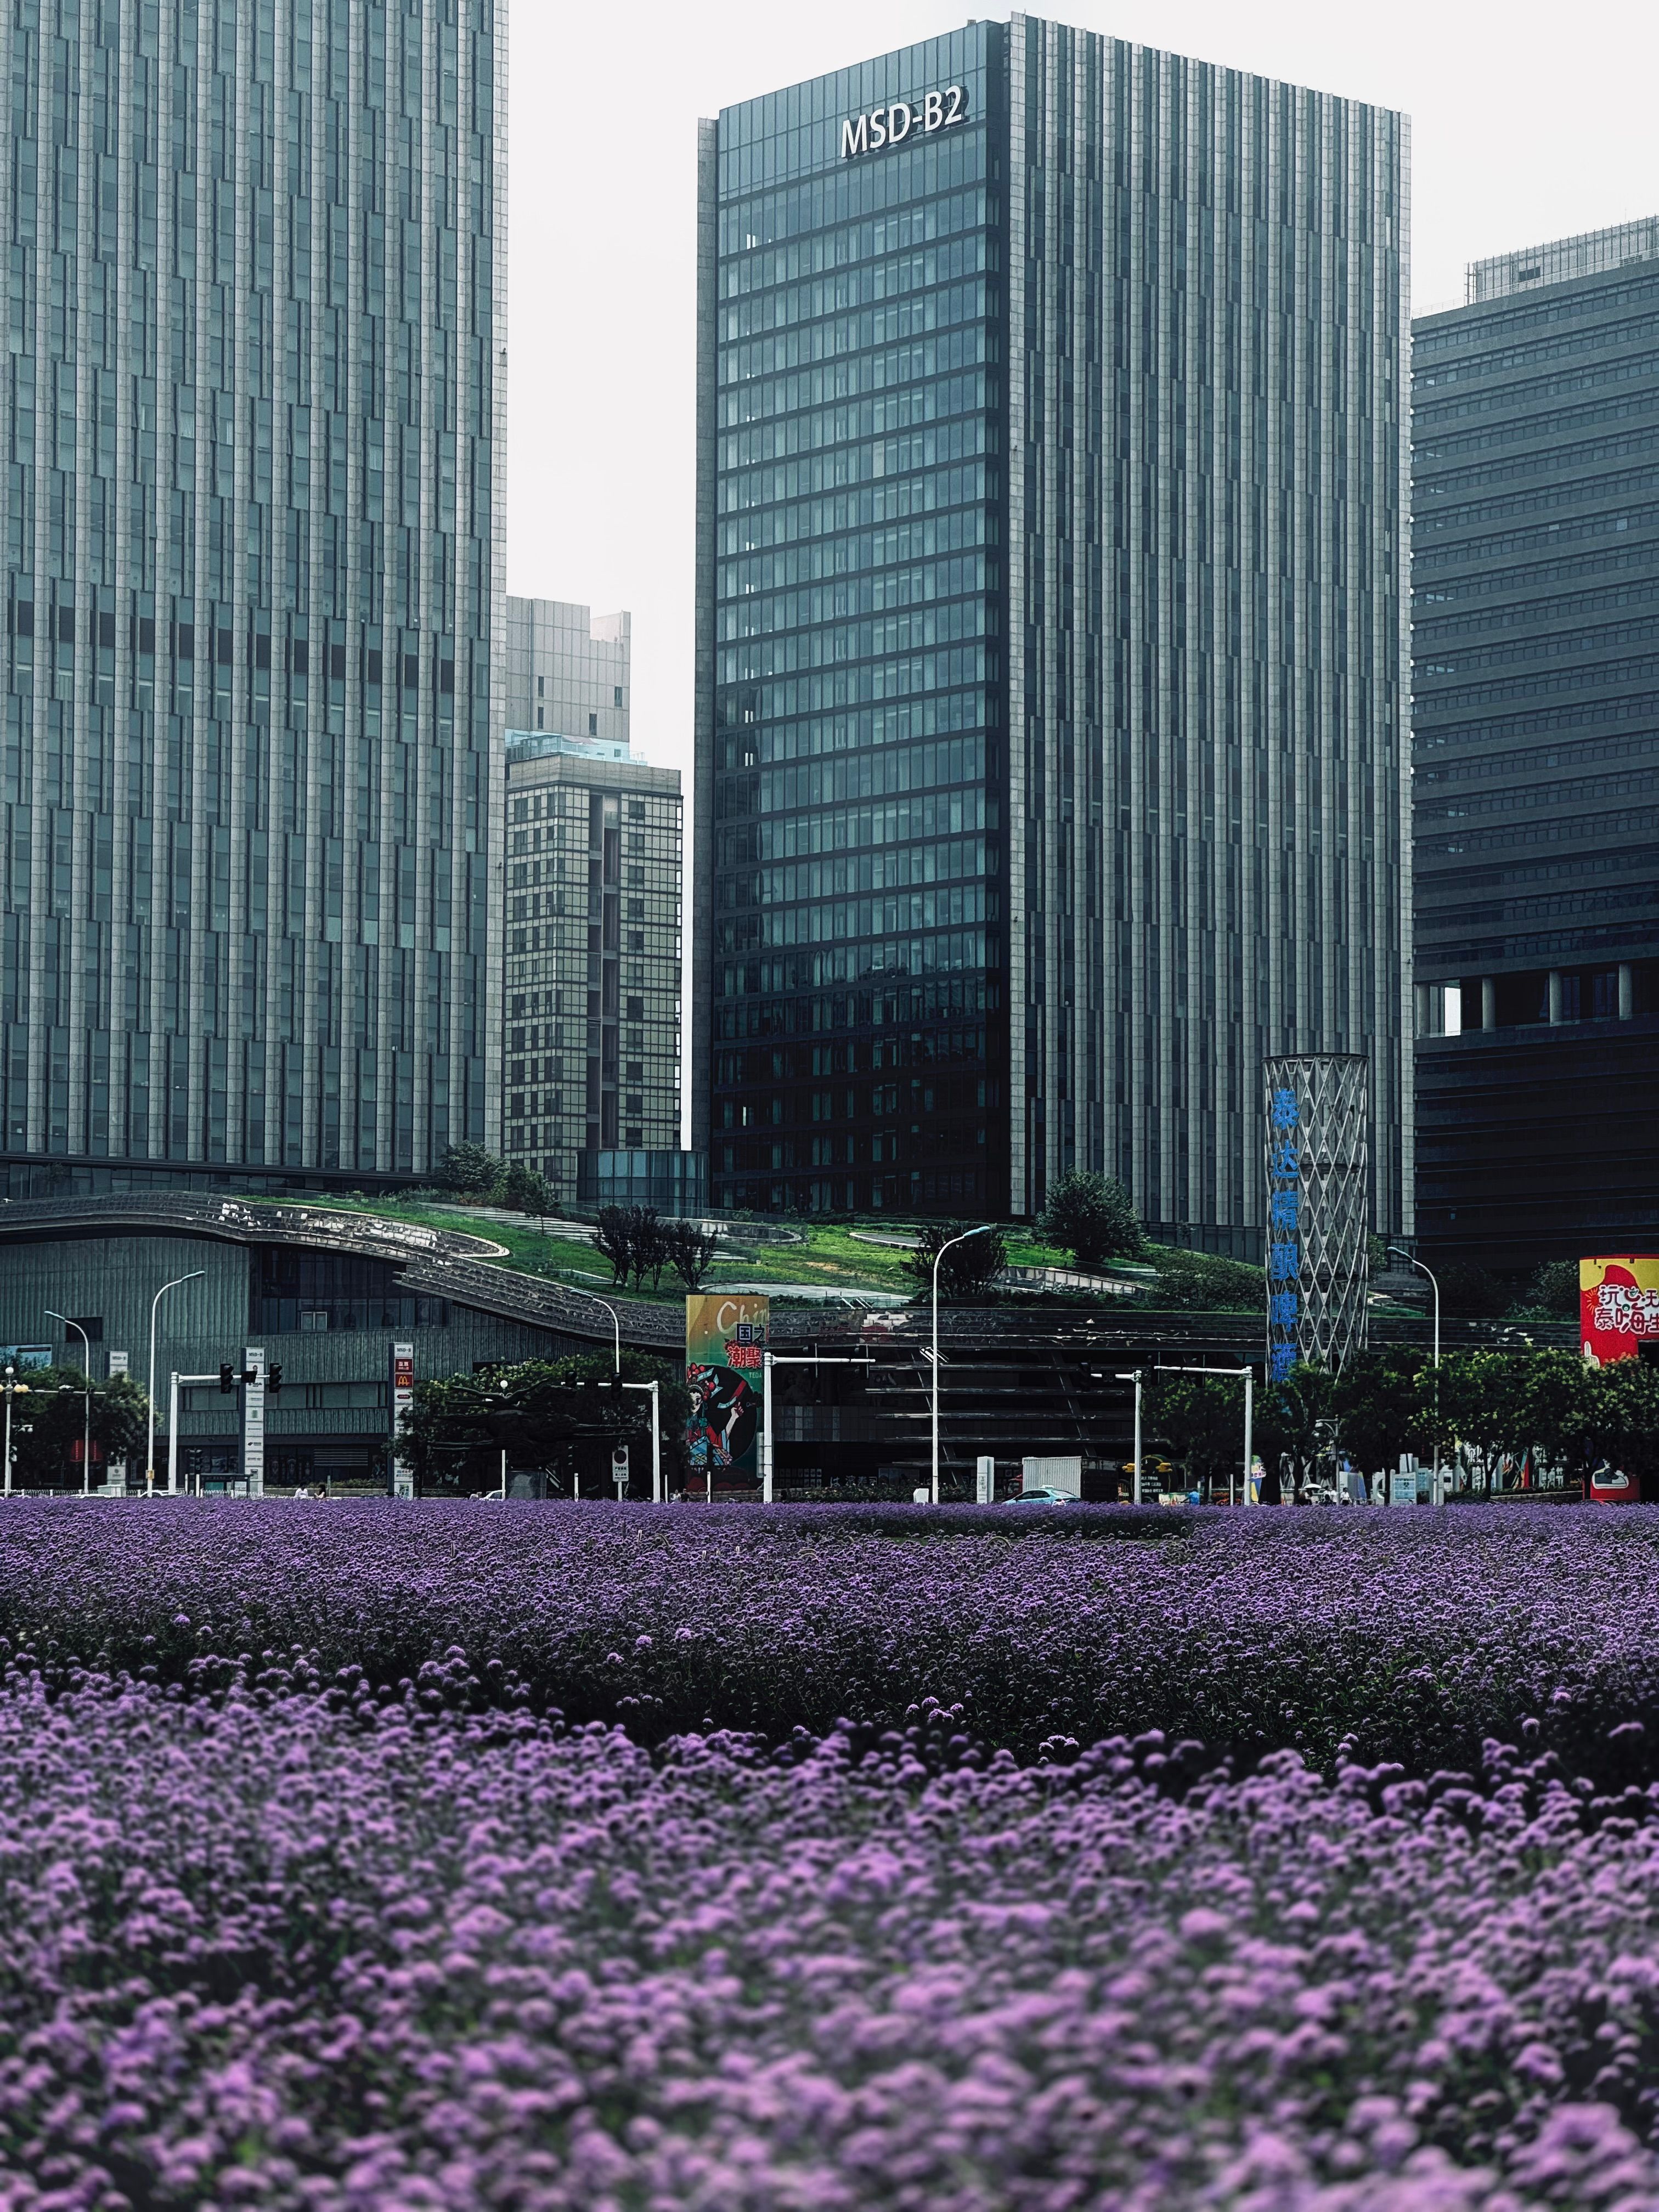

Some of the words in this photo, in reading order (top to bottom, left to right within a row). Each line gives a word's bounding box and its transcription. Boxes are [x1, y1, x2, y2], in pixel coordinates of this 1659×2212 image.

[841, 84, 962, 158] MSD-B2
[736, 1323, 769, 1343] 国之
[727, 1346, 763, 1369] 潮聚
